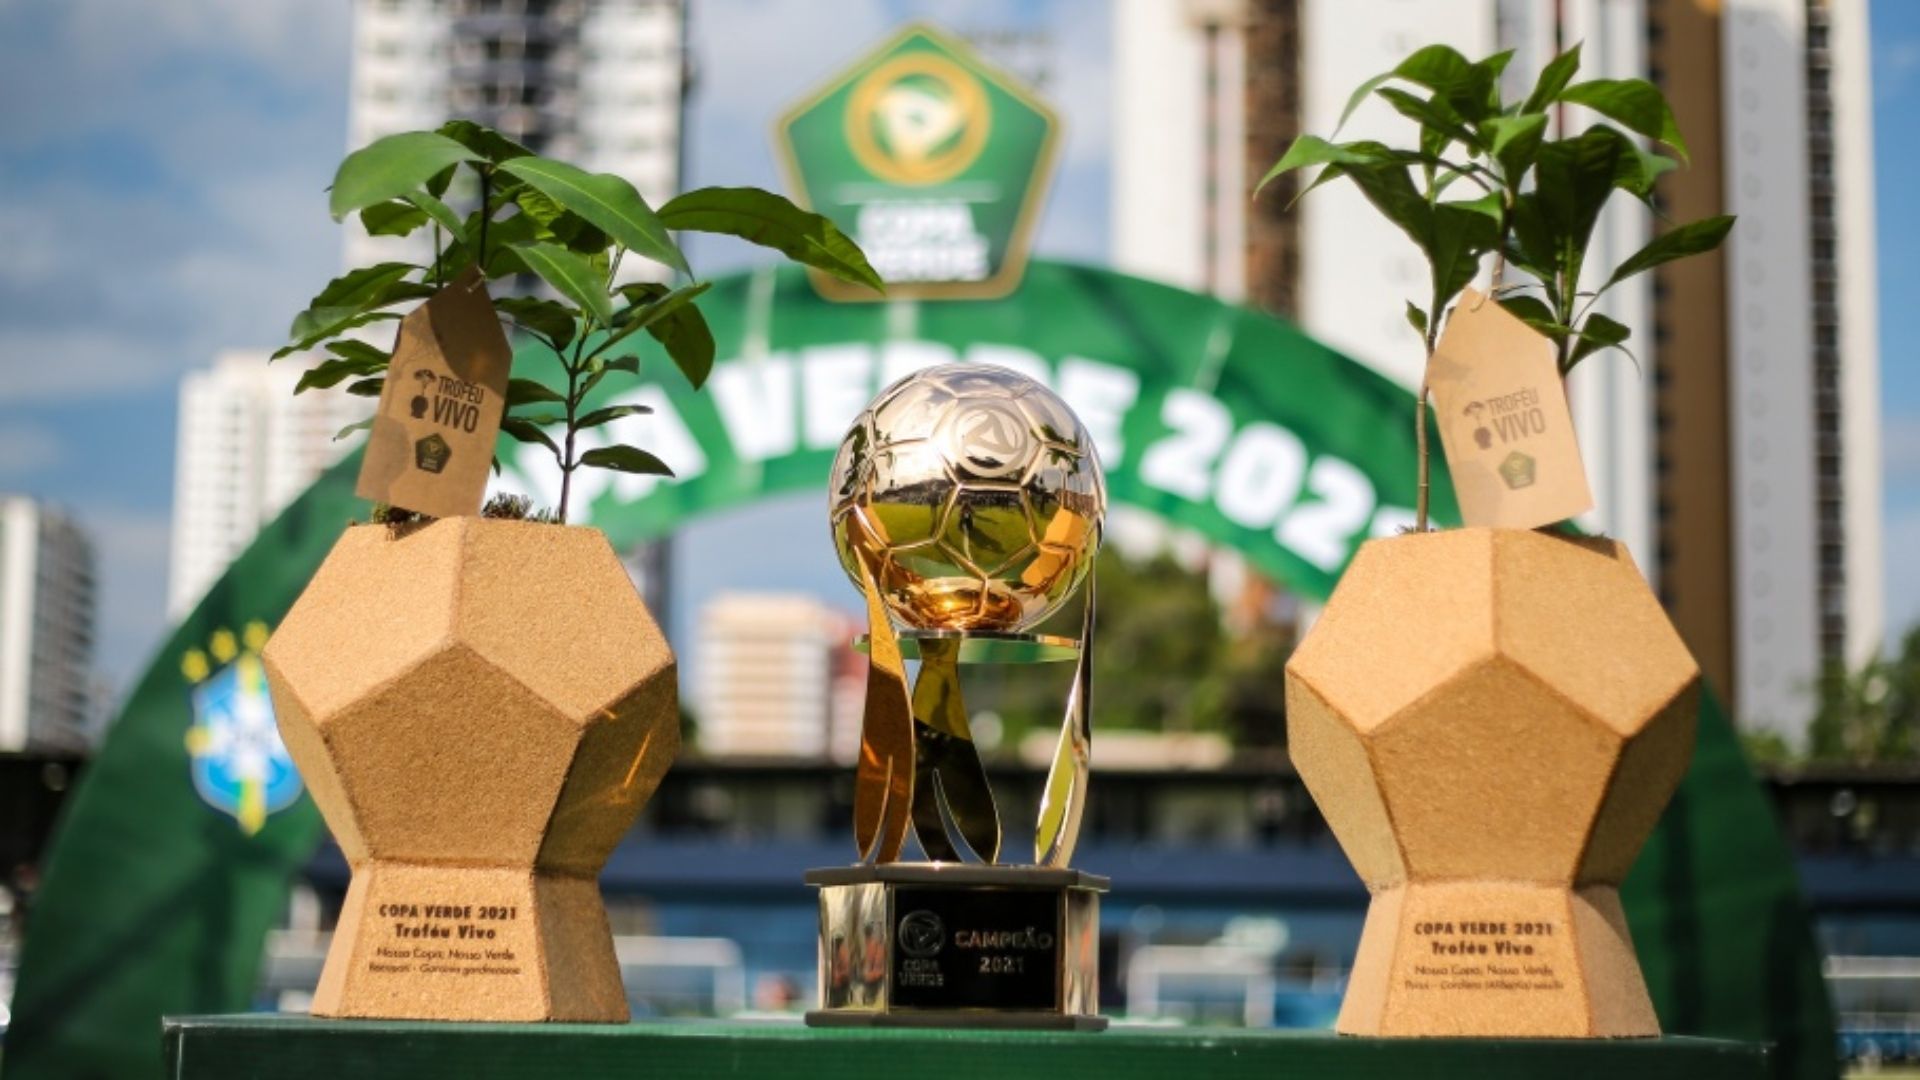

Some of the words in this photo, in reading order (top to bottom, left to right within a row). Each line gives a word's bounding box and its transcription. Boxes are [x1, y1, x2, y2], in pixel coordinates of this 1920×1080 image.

[438, 376, 484, 404] TROFÉU
[1485, 387, 1540, 416] TROFÉU
[434, 395, 479, 433] VIVO
[1492, 407, 1546, 443] VIVO
[1137, 388, 1442, 575] 202
[379, 904, 418, 918] COPA
[425, 905, 471, 919] VERDE
[479, 906, 516, 920] 2021
[395, 923, 450, 938] Troféu
[458, 925, 496, 939] Vivo
[1414, 922, 1454, 935] COPA
[1459, 922, 1507, 935] VERDE
[1514, 922, 1552, 935] 2021
[955, 926, 1054, 949] CAMPEÃO
[485, 949, 515, 960] Verde
[1431, 941, 1487, 955] Troféu
[1494, 941, 1534, 955] Vivo
[902, 959, 940, 971] COPA
[978, 956, 1024, 973] 2021
[1523, 965, 1553, 975] Verde
